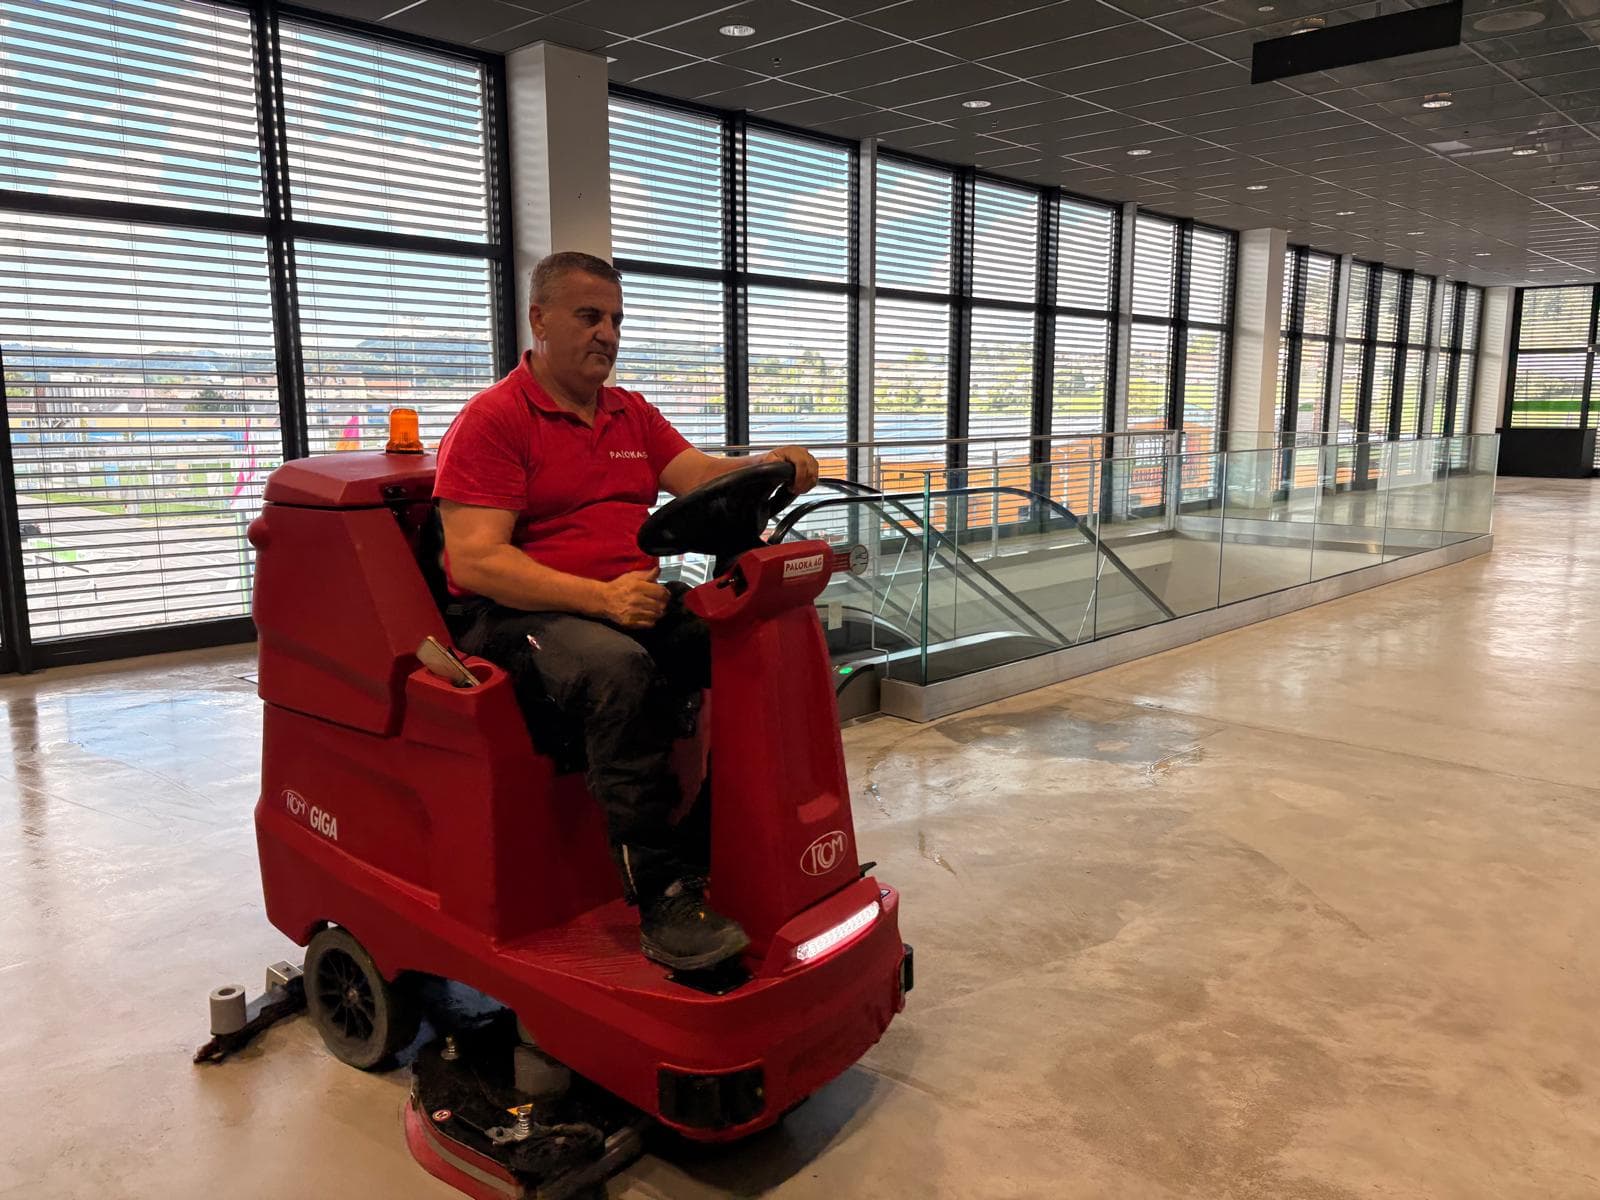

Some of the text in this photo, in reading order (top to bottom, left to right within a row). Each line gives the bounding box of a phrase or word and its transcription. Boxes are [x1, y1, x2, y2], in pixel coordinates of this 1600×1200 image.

[785, 561, 812, 572] PALOKA
[814, 557, 823, 567] AG
[310, 805, 338, 841] GIGA
